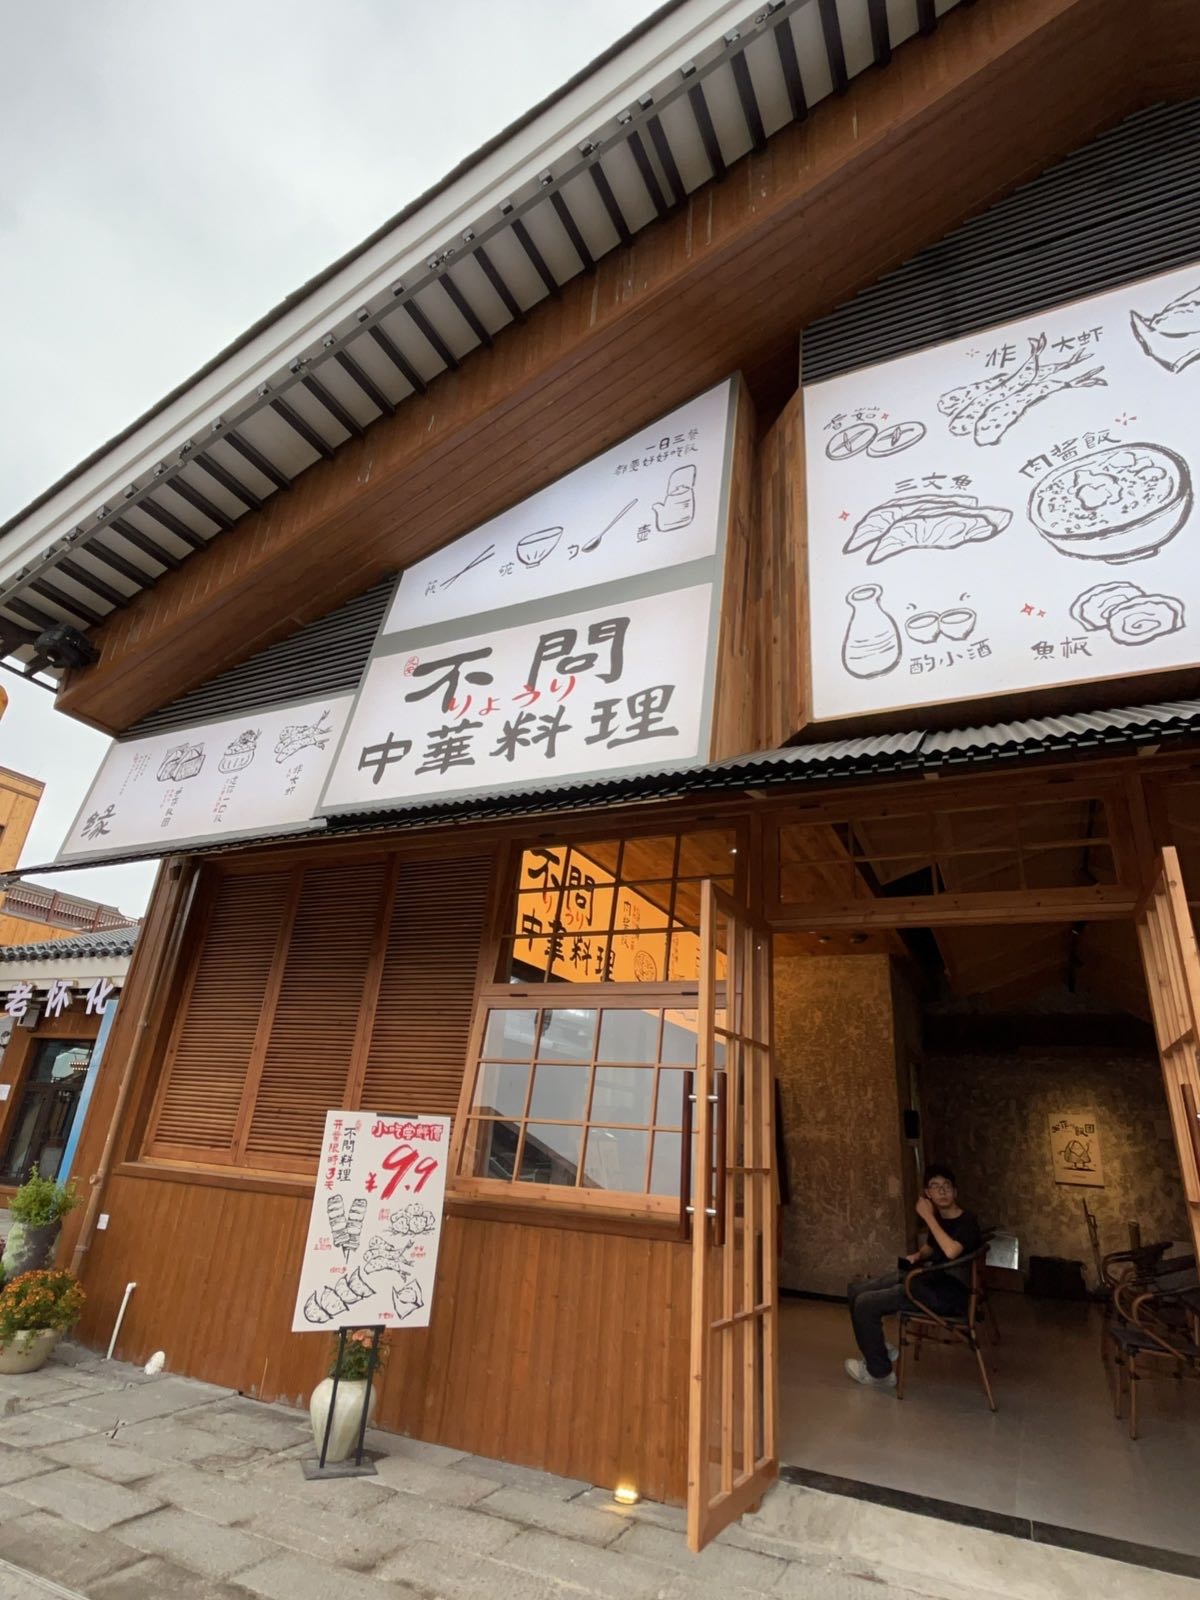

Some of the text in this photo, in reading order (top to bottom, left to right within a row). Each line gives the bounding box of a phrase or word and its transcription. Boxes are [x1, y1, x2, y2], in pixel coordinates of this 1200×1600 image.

[894, 471, 973, 494] 三文魚
[404, 616, 631, 714] 不問
[909, 638, 993, 675] 酌小酒
[1030, 636, 1093, 661] 魚板
[447, 674, 577, 721] りょうり
[358, 684, 680, 785] 中華料理
[5, 978, 114, 1017] 老怀化
[337, 1127, 357, 1182] 不問料理
